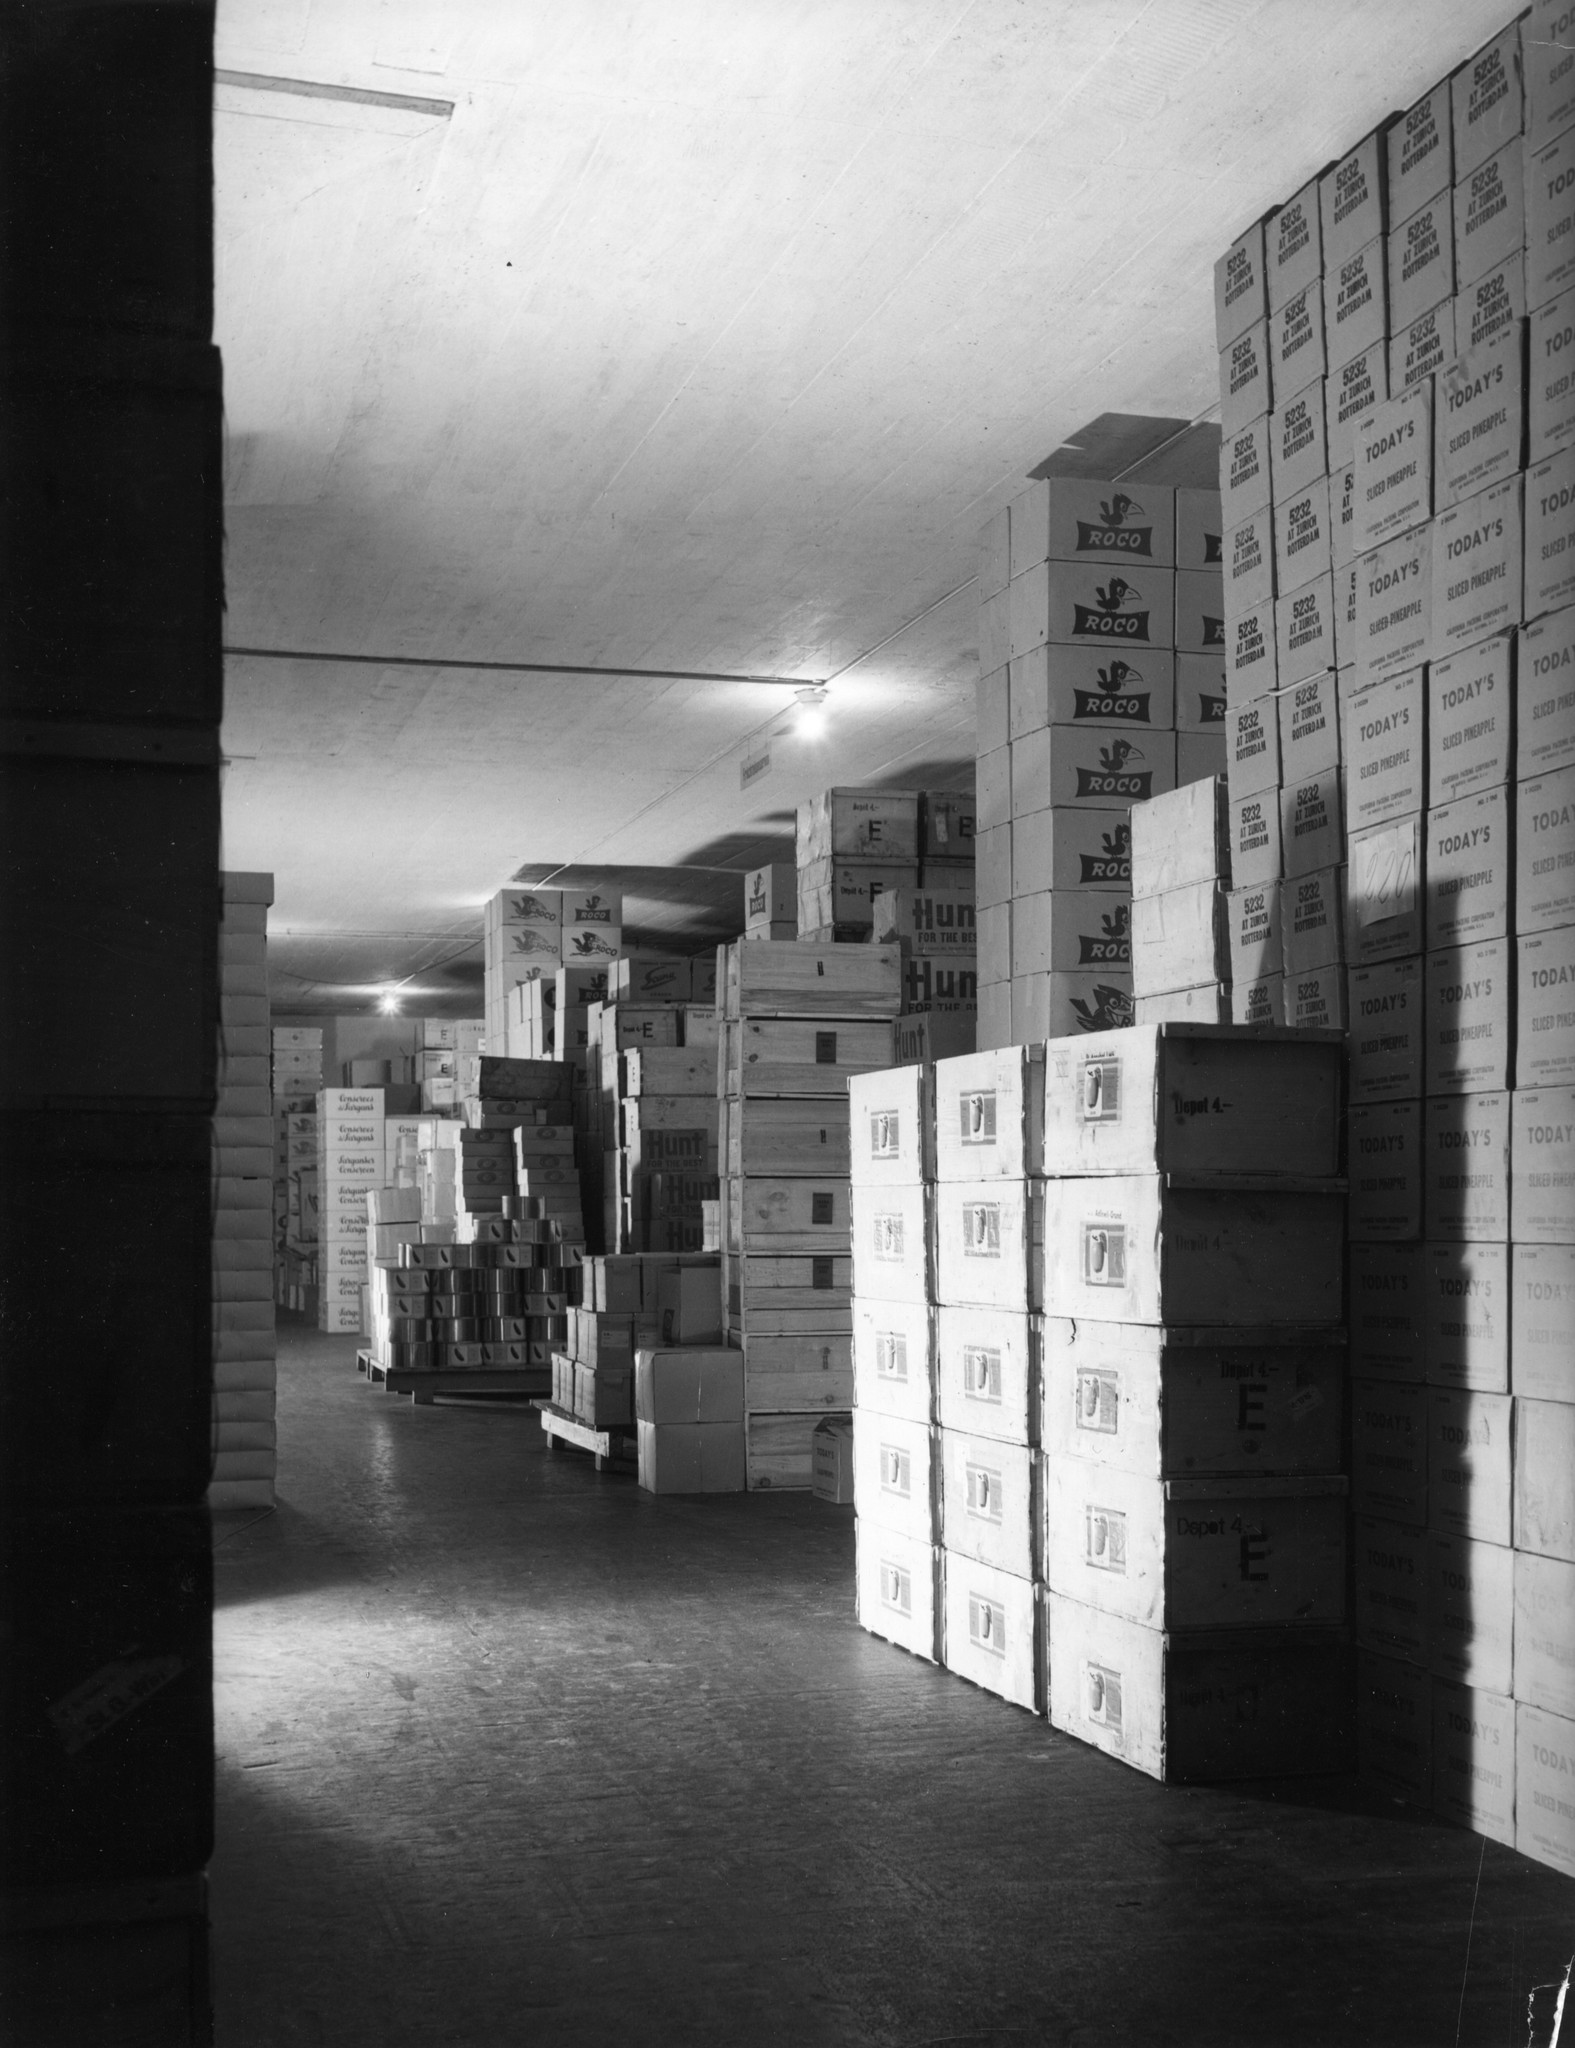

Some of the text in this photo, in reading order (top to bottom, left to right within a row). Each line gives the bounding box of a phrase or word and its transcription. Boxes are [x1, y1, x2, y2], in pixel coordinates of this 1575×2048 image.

[1474, 48, 1500, 86] 5232
[1468, 80, 1508, 126] ROTTERDAM
[1470, 90, 1477, 108] AT
[1407, 100, 1431, 135] 5232
[1402, 133, 1439, 175] ROTTERDAM
[1403, 140, 1410, 157] AT
[1477, 274, 1504, 307] 5232
[1472, 292, 1509, 328] AT ZURICH
[1410, 314, 1436, 347] 5232
[1472, 307, 1512, 346] ROTTERDAM
[1406, 334, 1440, 368] AT ZURICH
[1343, 357, 1367, 386] 5232
[1405, 349, 1444, 386] ROTTERDAM
[1340, 375, 1371, 407] AT ZURICH
[1449, 364, 1503, 412] TODAY'S
[1285, 400, 1306, 429] 5232
[1339, 390, 1375, 424] ROTTERDAM
[1283, 429, 1314, 461] ROTTERDAM
[1284, 416, 1311, 446] AT ZURICH
[1366, 420, 1414, 463] TODAY'S
[1449, 408, 1507, 454] SLICED PINEAPPLE
[1366, 460, 1417, 502] SLICED PINEAPPLE
[1289, 498, 1311, 526] 5232
[1088, 530, 1141, 548] ROCO
[1287, 527, 1319, 557] ROTTERDAM
[1288, 514, 1317, 542] AT ZURICH
[1447, 518, 1503, 560] TODAY'S
[1369, 558, 1419, 598] TODAY'S
[1447, 562, 1506, 601] SLICED PINEAPPLE
[1293, 594, 1315, 619] 5232
[1369, 600, 1422, 636] SLICED PINEAPPLE
[1085, 616, 1139, 633] ROCO
[1238, 616, 1258, 640] 5232
[1289, 611, 1319, 636] AT ZURICH
[1289, 624, 1322, 651] ROTTERDAM
[1235, 646, 1265, 670] ROTTERDAM
[1236, 632, 1263, 656] AT ZURICH
[1086, 698, 1140, 713] ROCO
[1295, 683, 1318, 708] 5232
[1442, 672, 1494, 711] TODAY'S
[1292, 701, 1322, 726] AT ZURICH
[1360, 707, 1409, 742] TODAY'S
[1292, 716, 1326, 742] ROTTERDAM
[1442, 717, 1495, 752] SLICED PINEAPPLE
[1360, 749, 1410, 780] SLICED PINEAPPLE
[1088, 777, 1142, 793] ROCO
[959, 816, 973, 838] E
[1241, 803, 1261, 825] 5232
[869, 820, 882, 841] E
[1240, 819, 1267, 839] AT ZURICH
[1240, 833, 1269, 853] ROTTERDAM
[1438, 825, 1490, 857] TODAY'S
[1091, 862, 1131, 877] ROC
[1438, 869, 1493, 897] SLICED PINEAPPLE
[1244, 894, 1265, 915] 5232
[1298, 881, 1320, 903] 5232
[581, 911, 606, 919] ROCO
[912, 898, 976, 930] Hun
[1241, 912, 1268, 931] AT ZURICH
[1294, 906, 1302, 919] AT
[1294, 913, 1327, 934] ROTTERDAM
[918, 931, 977, 944] FOR THE BES
[1090, 943, 1130, 958] ROC
[1241, 926, 1272, 947] ROTTERDAM
[905, 961, 977, 1002] Hun
[1532, 964, 1575, 988] TODAY
[586, 991, 608, 999] ROC
[1361, 993, 1407, 1016] TODAY'S
[1440, 978, 1492, 1004] TODAY'S
[908, 1003, 932, 1014] FOR
[643, 1022, 654, 1038] E
[894, 1022, 925, 1064] Hunt
[441, 1063, 448, 1074] E
[1174, 1096, 1208, 1117] Depot
[646, 1131, 702, 1159] Hunt
[1439, 1129, 1491, 1149] TODAY'S
[666, 1221, 703, 1251] Hu
[1238, 1384, 1267, 1430] E
[1240, 1534, 1269, 1581] E
